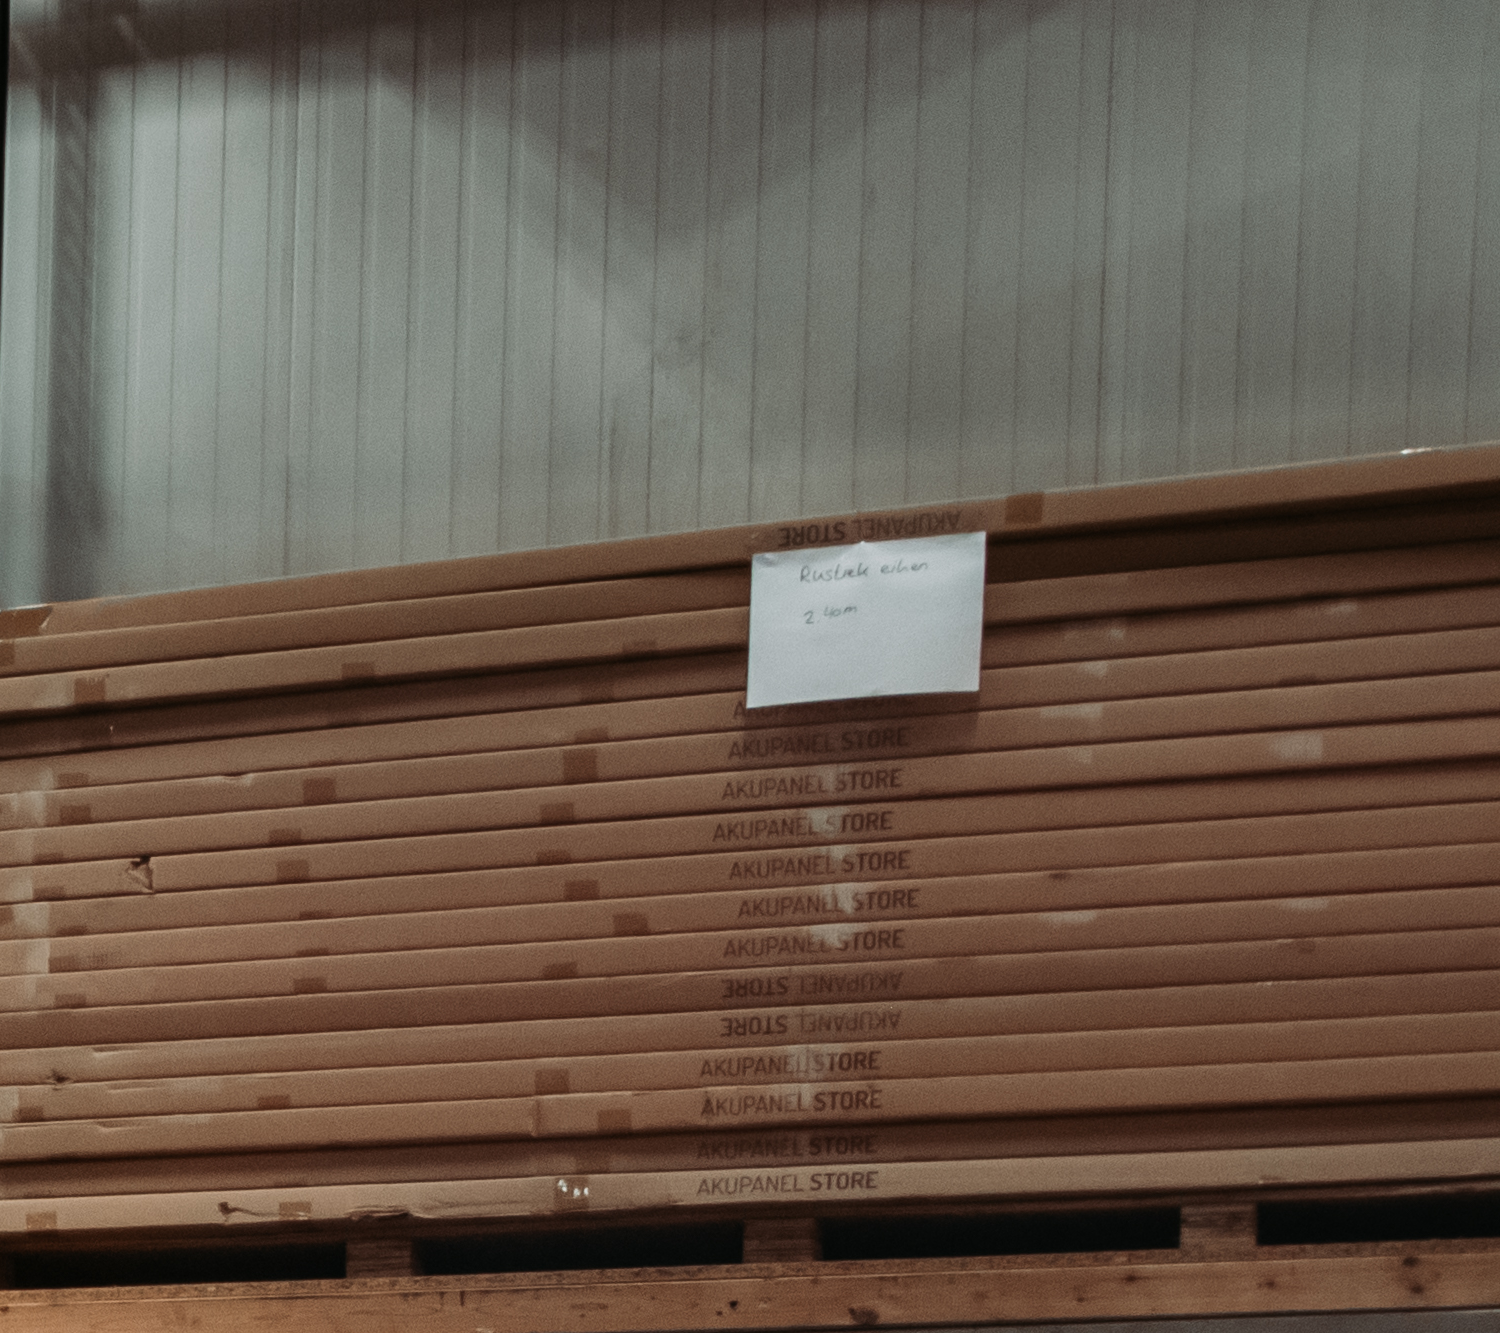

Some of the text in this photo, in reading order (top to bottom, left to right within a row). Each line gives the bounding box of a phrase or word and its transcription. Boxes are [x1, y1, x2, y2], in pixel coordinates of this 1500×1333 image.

[778, 520, 846, 547] STORE
[728, 727, 910, 759] AKUPANEL STORE
[722, 769, 902, 800] AKUPANEL STORE
[712, 811, 893, 842] AKUPANEL STORE
[729, 850, 911, 880] AKUPANEL STORE
[738, 889, 920, 918] AKUPANEL STORE
[724, 935, 829, 958] AKUPANEL
[723, 971, 903, 999] AKUPANEL STORE
[721, 1011, 902, 1037] AKUPANEL STORE
[700, 1051, 881, 1077] AKUPANEL STORE
[700, 1089, 882, 1116] AKUPANEL STORE
[697, 1135, 878, 1159] AKUPANEL STORE
[697, 1171, 879, 1196] AKUPANEL STORE
